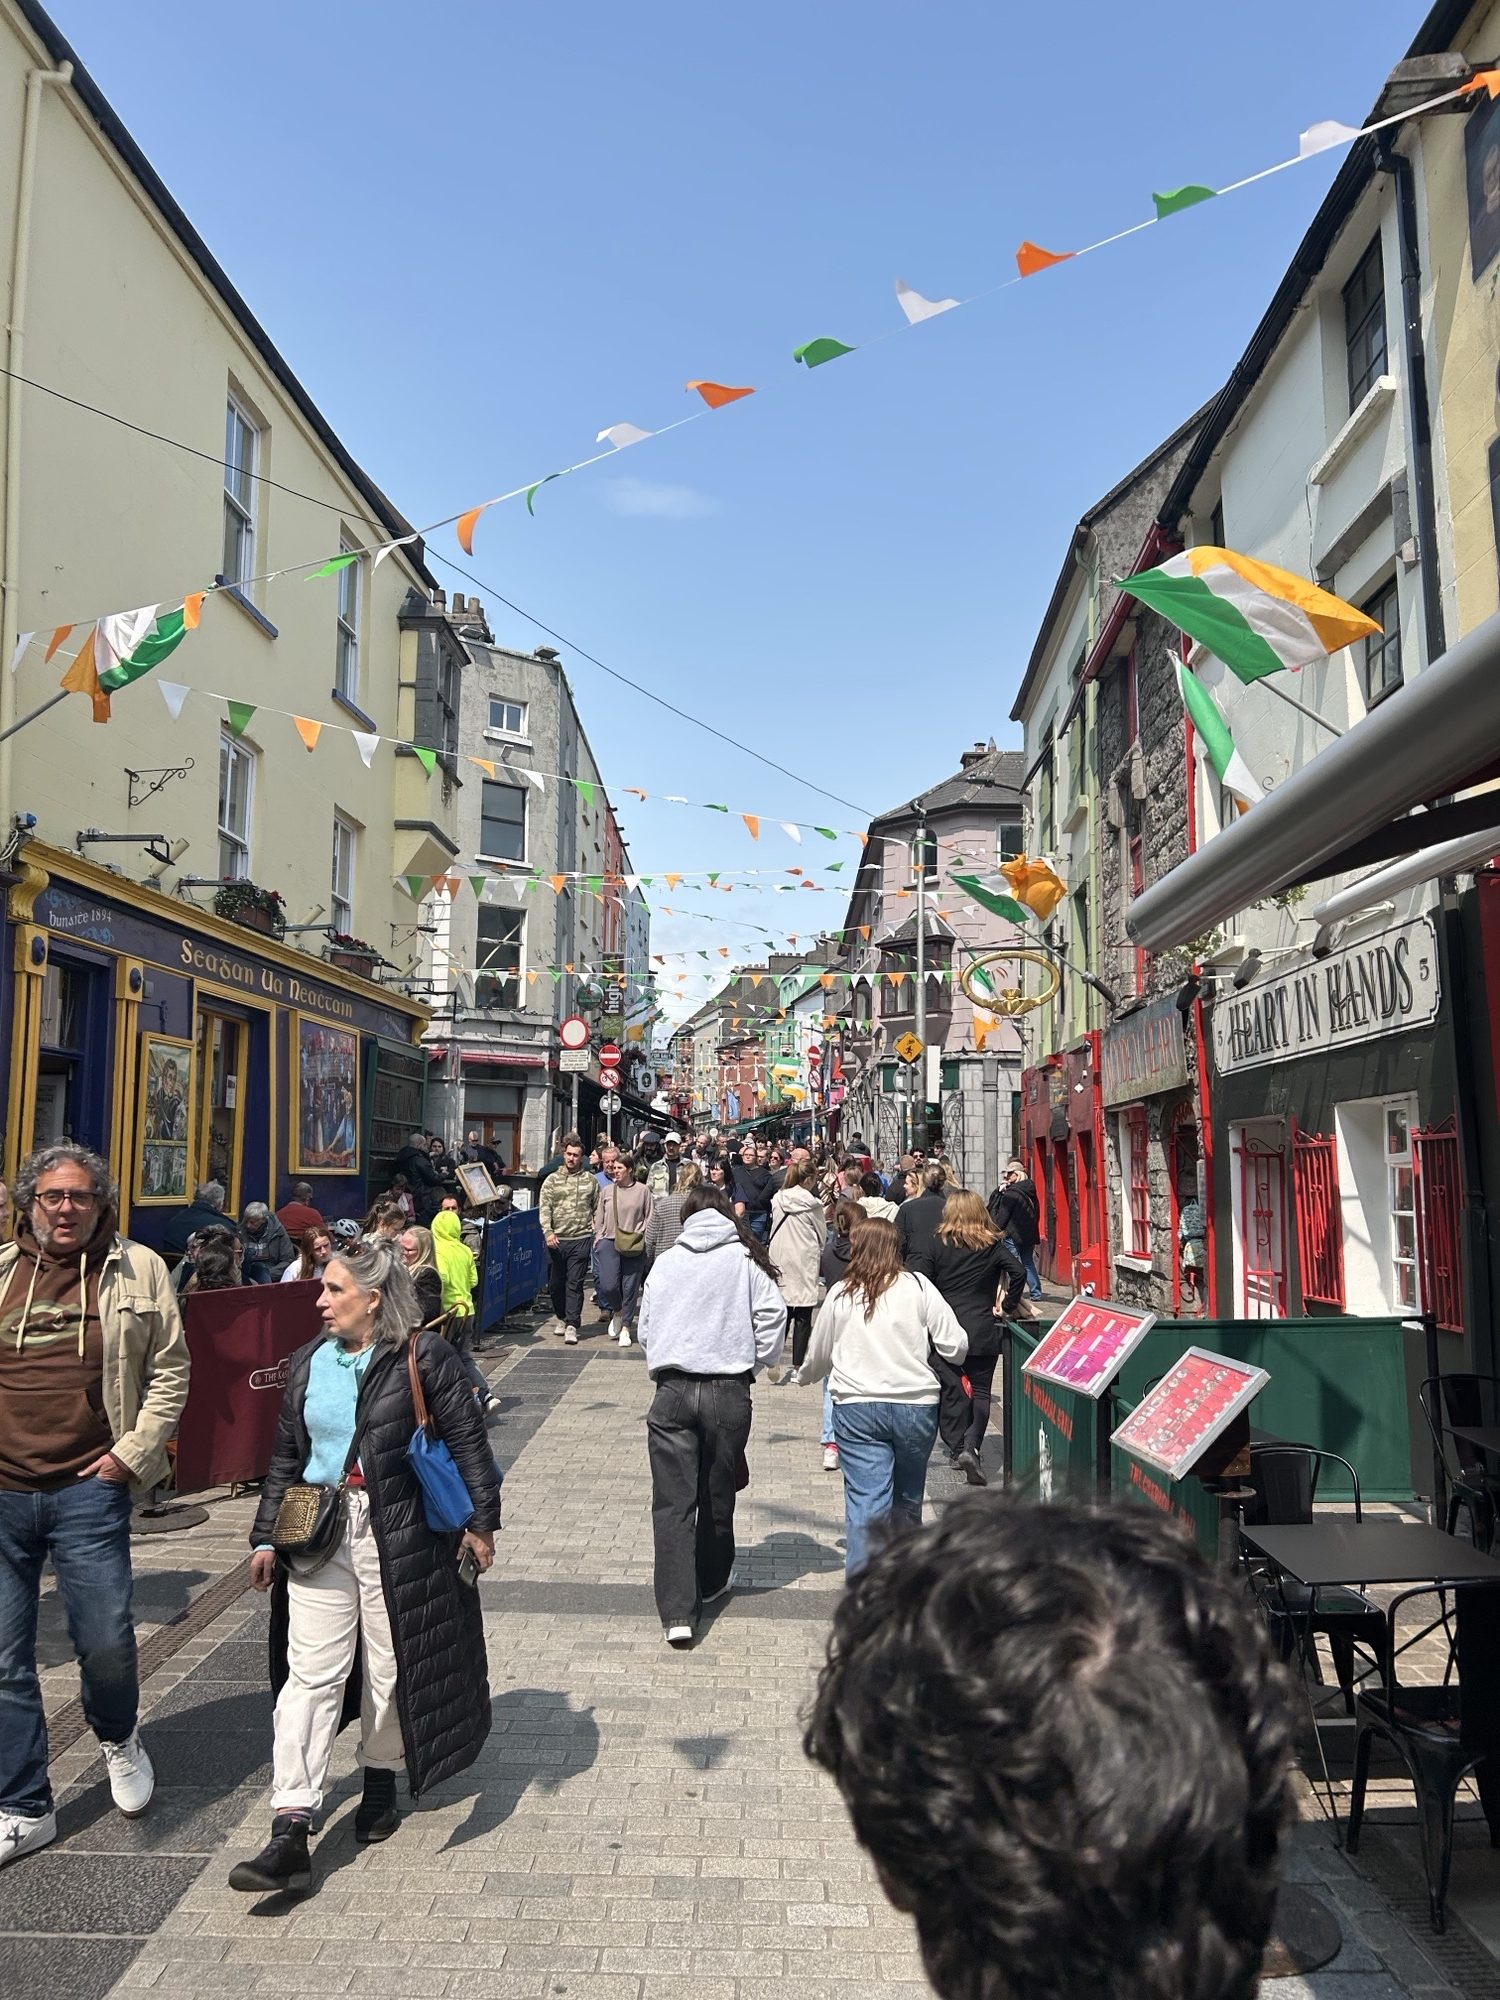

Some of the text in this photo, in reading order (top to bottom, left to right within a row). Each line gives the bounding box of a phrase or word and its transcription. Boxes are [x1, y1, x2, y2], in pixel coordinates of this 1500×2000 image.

[91, 908, 112, 922] 1894
[262, 967, 283, 995] Ua
[1419, 957, 1430, 981] 5
[1228, 936, 1413, 1061] HEART IN HANDS
[1143, 1014, 1179, 1080] HEART
[264, 1372, 277, 1383] THE
